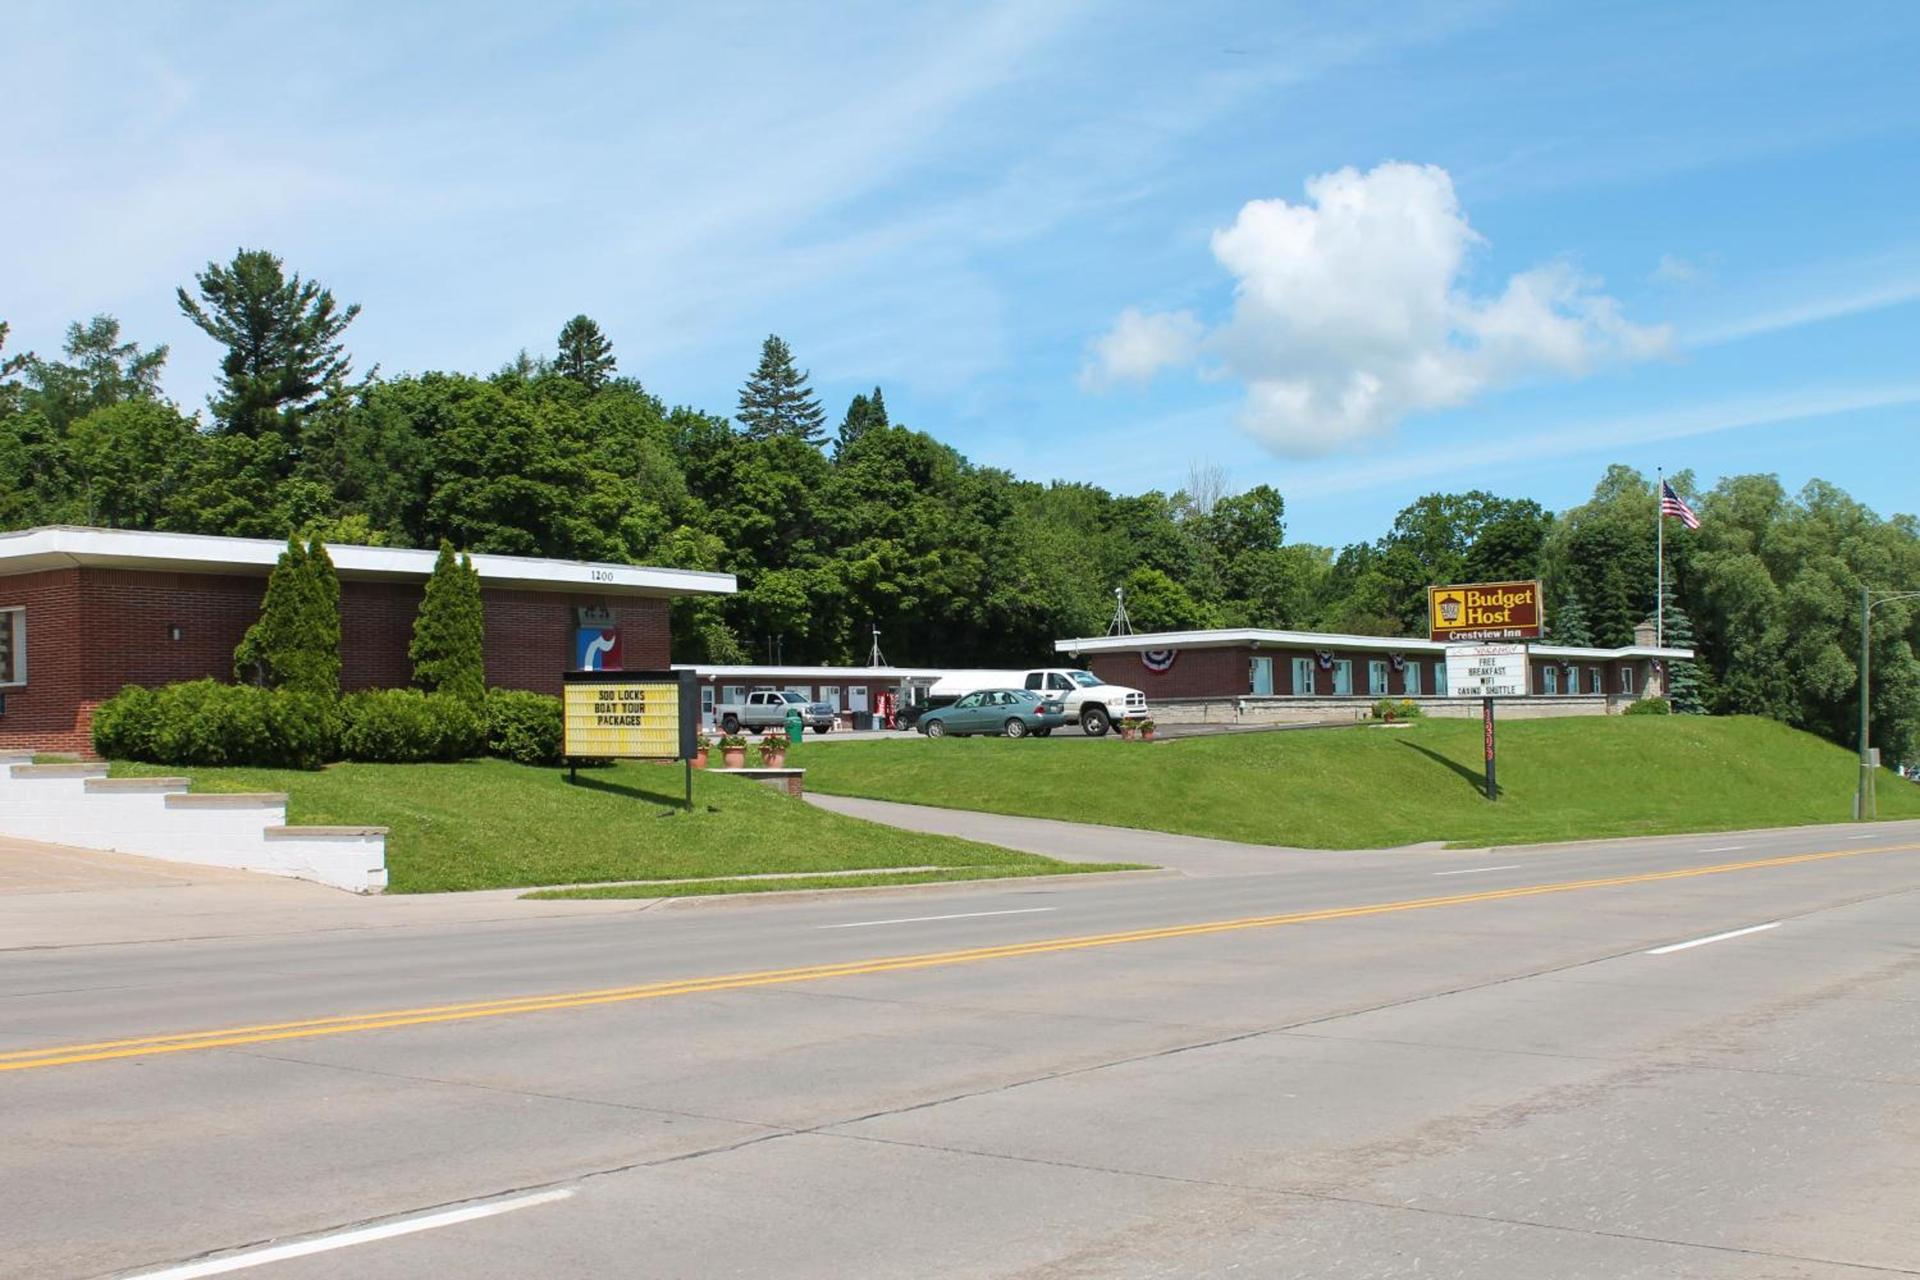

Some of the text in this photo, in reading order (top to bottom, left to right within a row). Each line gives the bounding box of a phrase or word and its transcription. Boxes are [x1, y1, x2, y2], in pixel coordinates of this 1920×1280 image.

[591, 570, 614, 582] 1200
[1467, 590, 1533, 608] Budget
[1467, 608, 1512, 624] Host
[1449, 629, 1522, 640] Crestview Inn
[1479, 658, 1496, 666] FREE
[1468, 667, 1506, 676] BREAKFAST
[598, 690, 646, 700] SOO LOCKS
[1485, 686, 1516, 695] SHUTTLE
[594, 703, 645, 713] BOAT TOUR
[597, 715, 642, 726] PACKAGES
